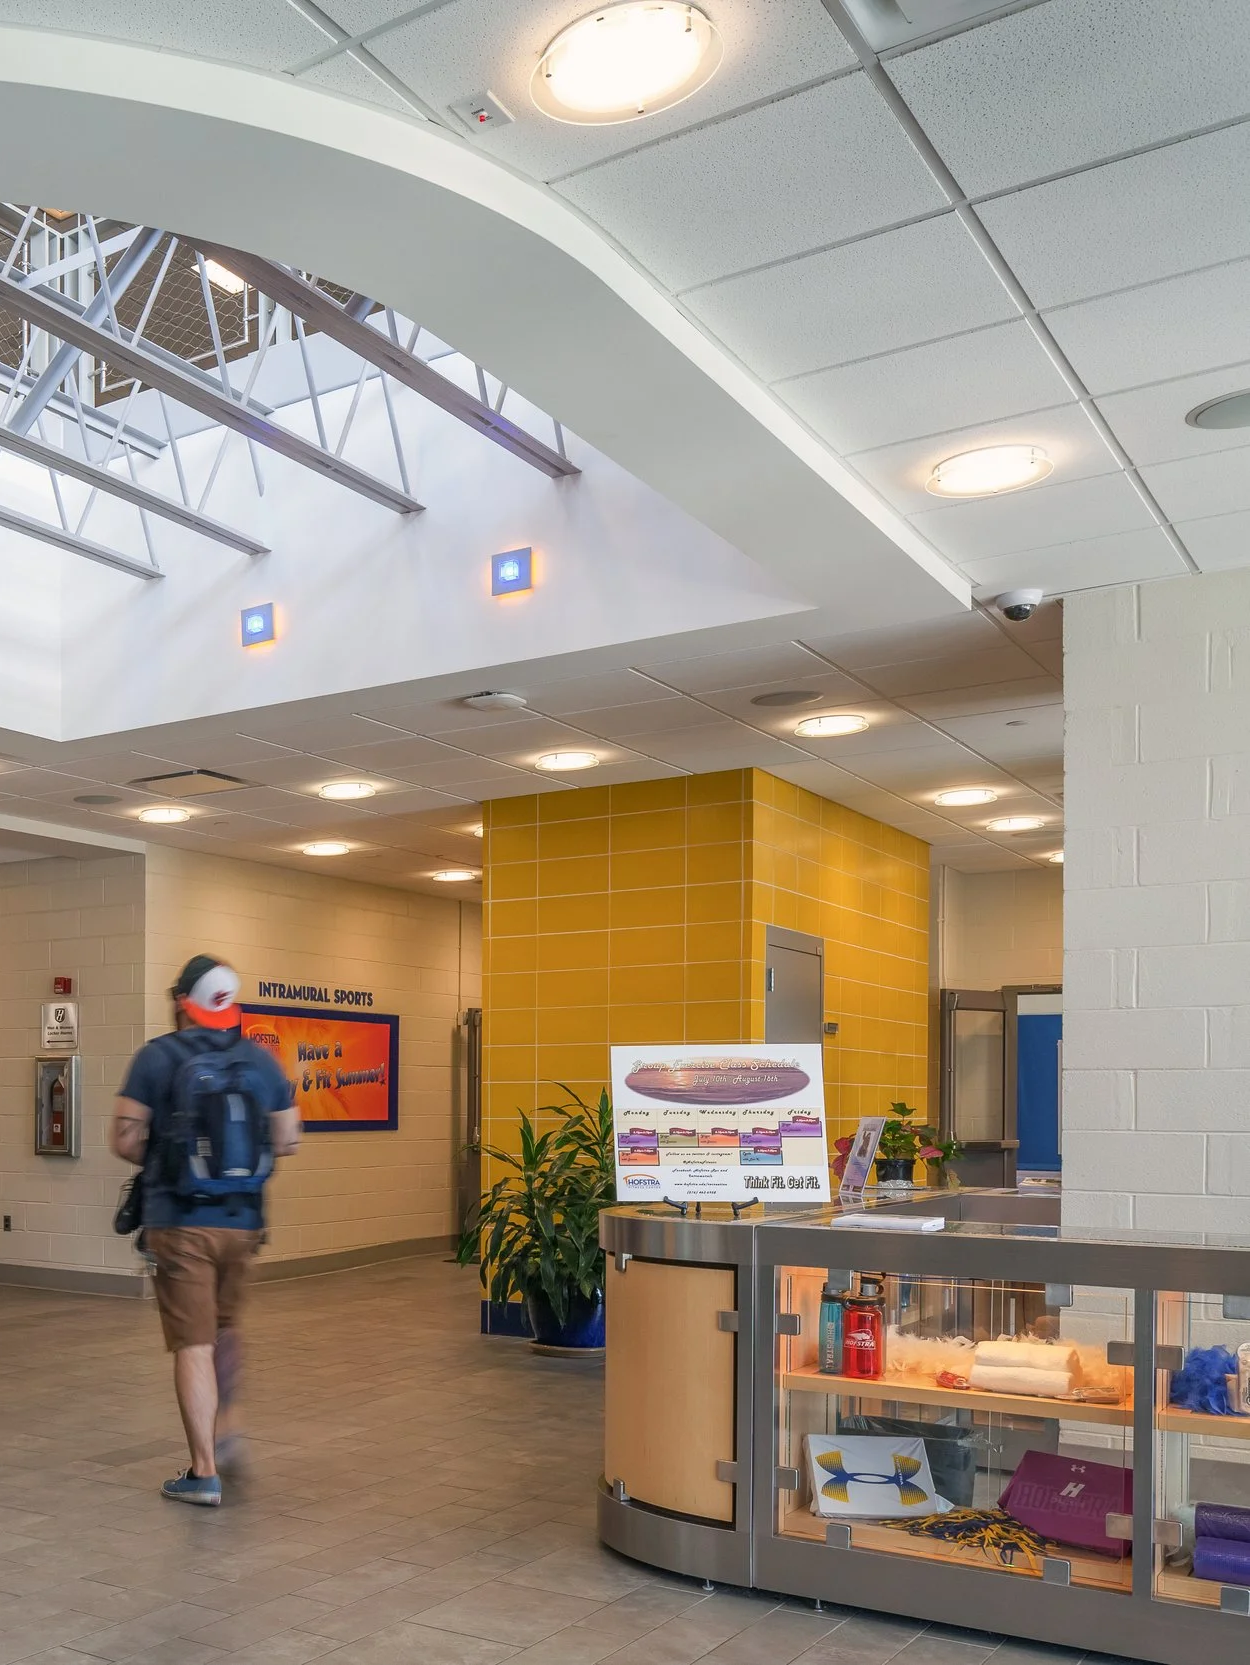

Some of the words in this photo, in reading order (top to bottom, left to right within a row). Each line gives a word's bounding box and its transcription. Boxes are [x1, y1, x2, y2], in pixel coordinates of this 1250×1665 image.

[258, 981, 330, 1003] INTRAMURAL
[334, 989, 373, 1007] SPORTS
[250, 1032, 280, 1045] HOFSTRA
[297, 1041, 330, 1062] Have
[334, 1041, 343, 1058] a
[631, 1059, 667, 1074] Group
[668, 1058, 715, 1073] Exercise
[719, 1058, 747, 1070] Class
[750, 1058, 800, 1071] Schedule
[302, 1068, 313, 1092] &
[315, 1069, 332, 1090] Fit
[335, 1062, 386, 1090] Summer!
[693, 1075, 710, 1087] July
[712, 1074, 727, 1083] 10th
[733, 1074, 761, 1086] August
[663, 1109, 691, 1117] Tuesday
[744, 1175, 769, 1189] Think
[771, 1175, 785, 1189] Fit.
[787, 1175, 804, 1189] Get
[805, 1175, 821, 1189] Fit.
[845, 1340, 876, 1348] HOFSTRA
